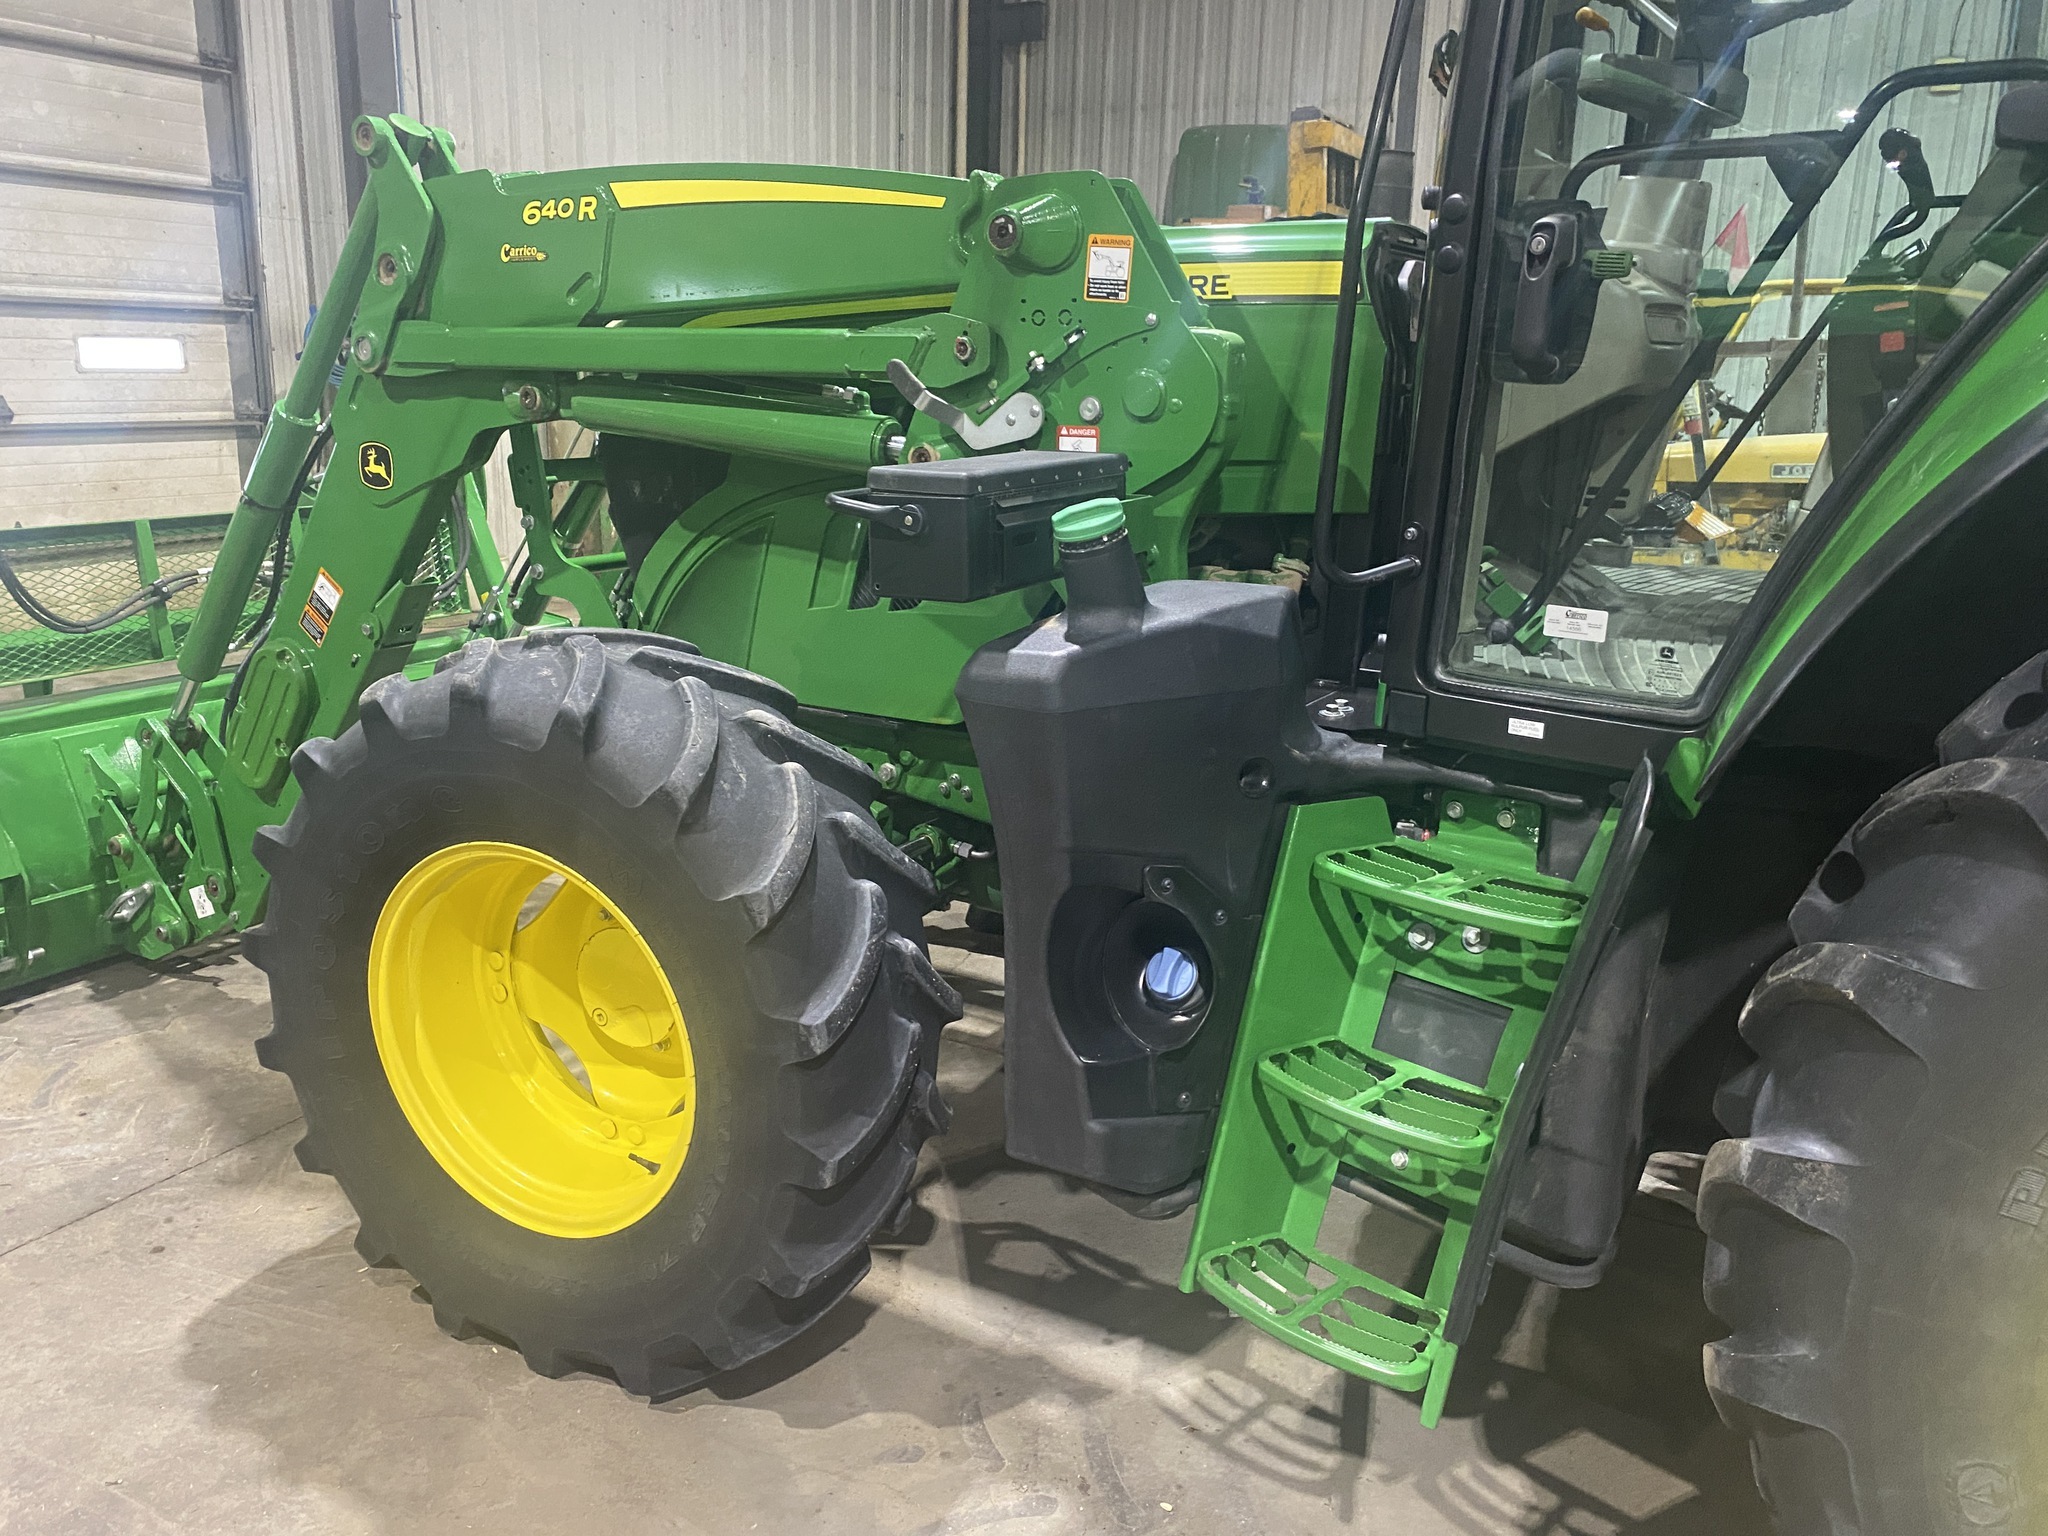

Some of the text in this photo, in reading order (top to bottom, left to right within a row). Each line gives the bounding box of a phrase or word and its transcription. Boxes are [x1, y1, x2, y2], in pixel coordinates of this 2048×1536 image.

[522, 197, 575, 226] 640
[1099, 238, 1131, 247] WARNING
[500, 243, 538, 263] Carrico
[1069, 428, 1096, 436] DANGER
